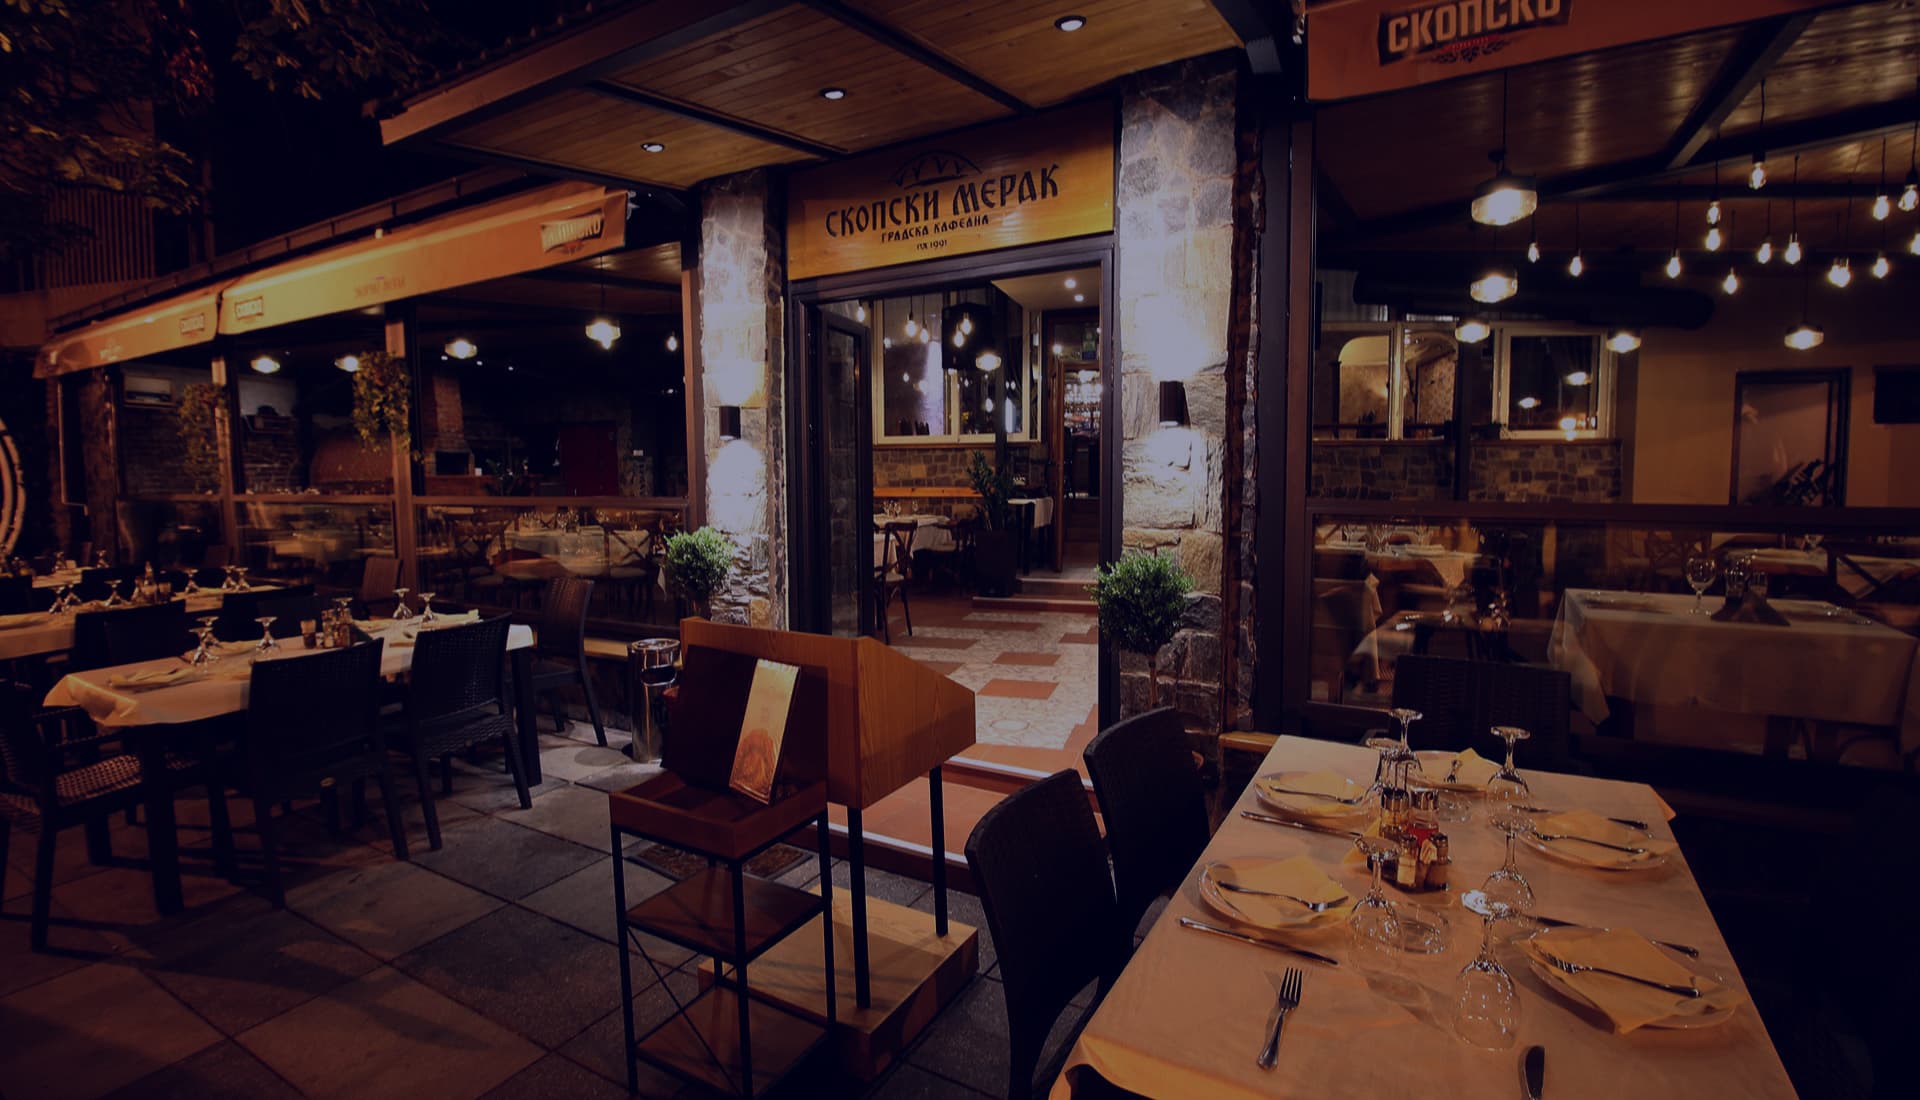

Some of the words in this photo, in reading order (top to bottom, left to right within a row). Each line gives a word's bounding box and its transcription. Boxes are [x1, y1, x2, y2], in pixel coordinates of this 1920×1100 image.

[825, 189, 940, 238] СКОПСКИ
[952, 163, 1060, 216] МЕРАК
[881, 225, 929, 243] ГРАДСКА
[933, 214, 990, 234] КАФЕАНА
